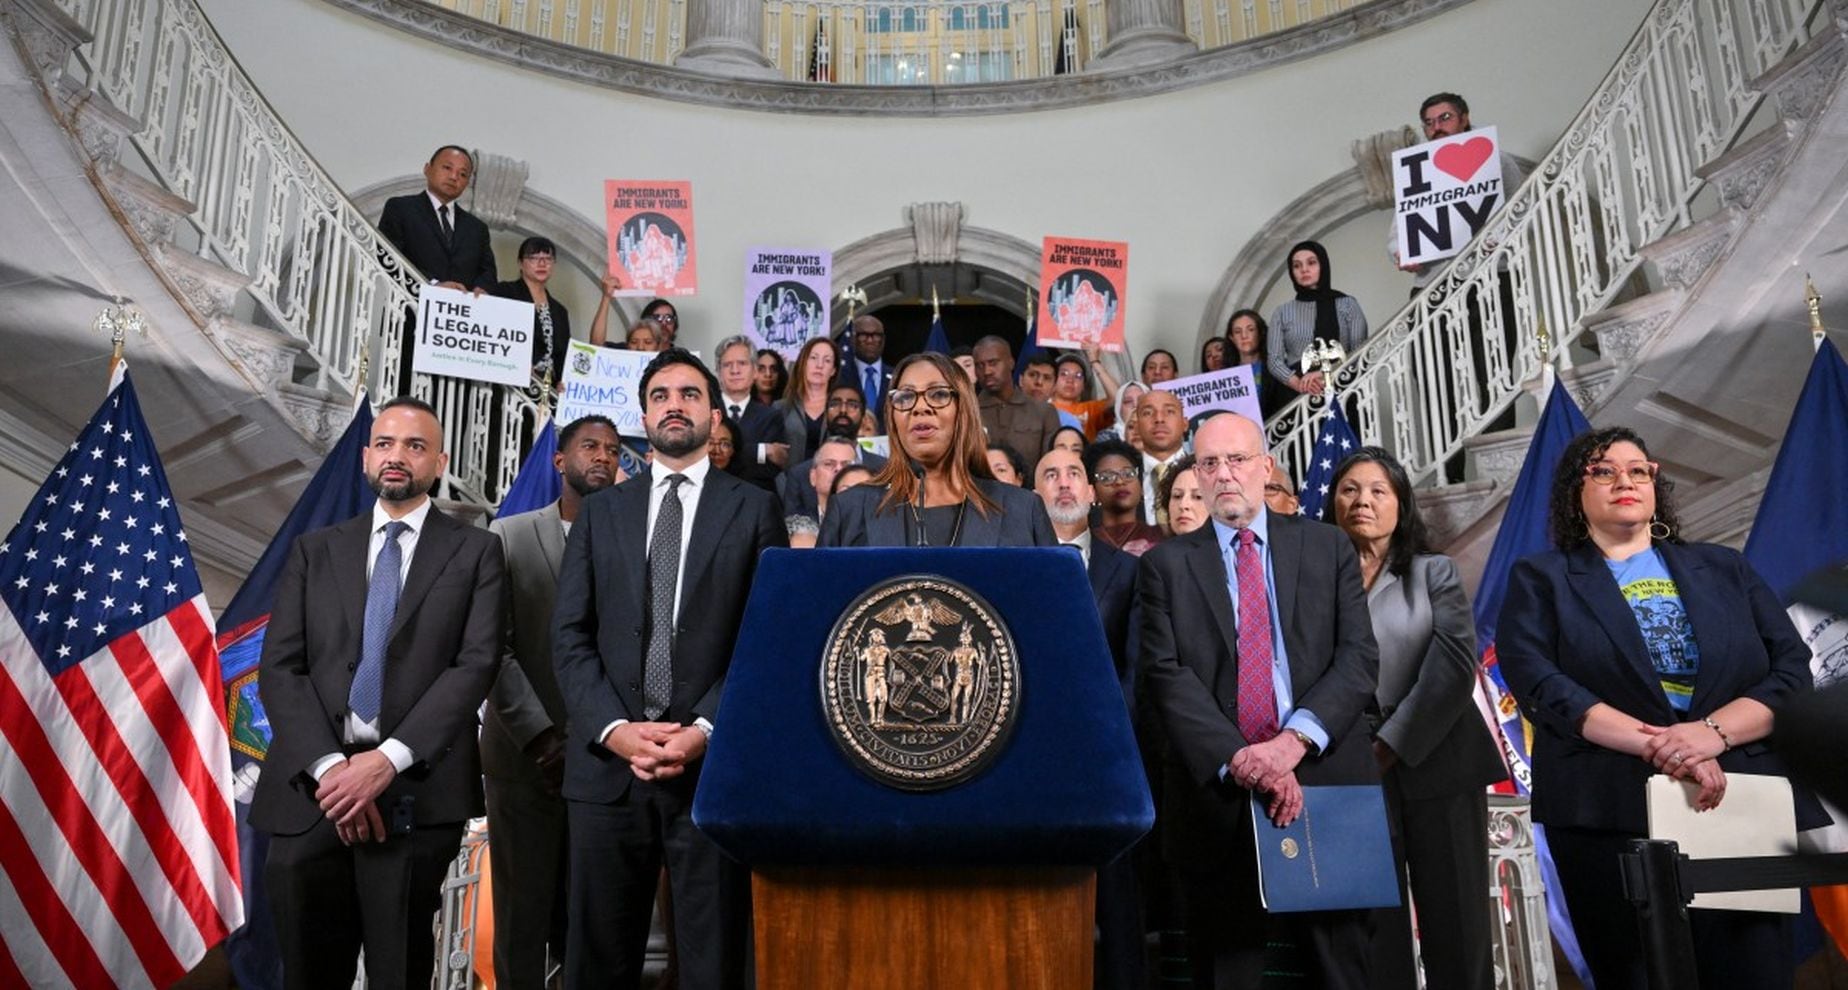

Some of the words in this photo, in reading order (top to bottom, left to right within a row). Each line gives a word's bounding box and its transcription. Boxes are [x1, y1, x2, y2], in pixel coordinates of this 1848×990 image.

[1400, 150, 1432, 198] I
[617, 187, 680, 198] IMMIGRANTS
[1398, 178, 1500, 213] IMMIGRANT
[613, 199, 632, 209] ARE
[634, 199, 656, 209] NEW
[658, 199, 688, 209] YORK!
[1405, 193, 1499, 258] NY
[757, 253, 821, 265] IMMIGRANTS
[1054, 244, 1116, 258] IMMIGRANTS
[752, 264, 770, 274] ARE
[772, 265, 794, 275] NEW
[796, 266, 826, 276] YORK!
[1049, 254, 1068, 264] ARE
[1070, 256, 1092, 266] NEW
[1094, 258, 1122, 268] YORK!
[435, 300, 471, 318] THE
[434, 317, 493, 338] LEGAL
[497, 328, 527, 343] AID
[432, 333, 511, 357] SOCIETY
[566, 382, 628, 405] HARMS
[1186, 393, 1212, 407] NEW
[1215, 386, 1250, 401] YORK!
[901, 733, 938, 745] 1625
